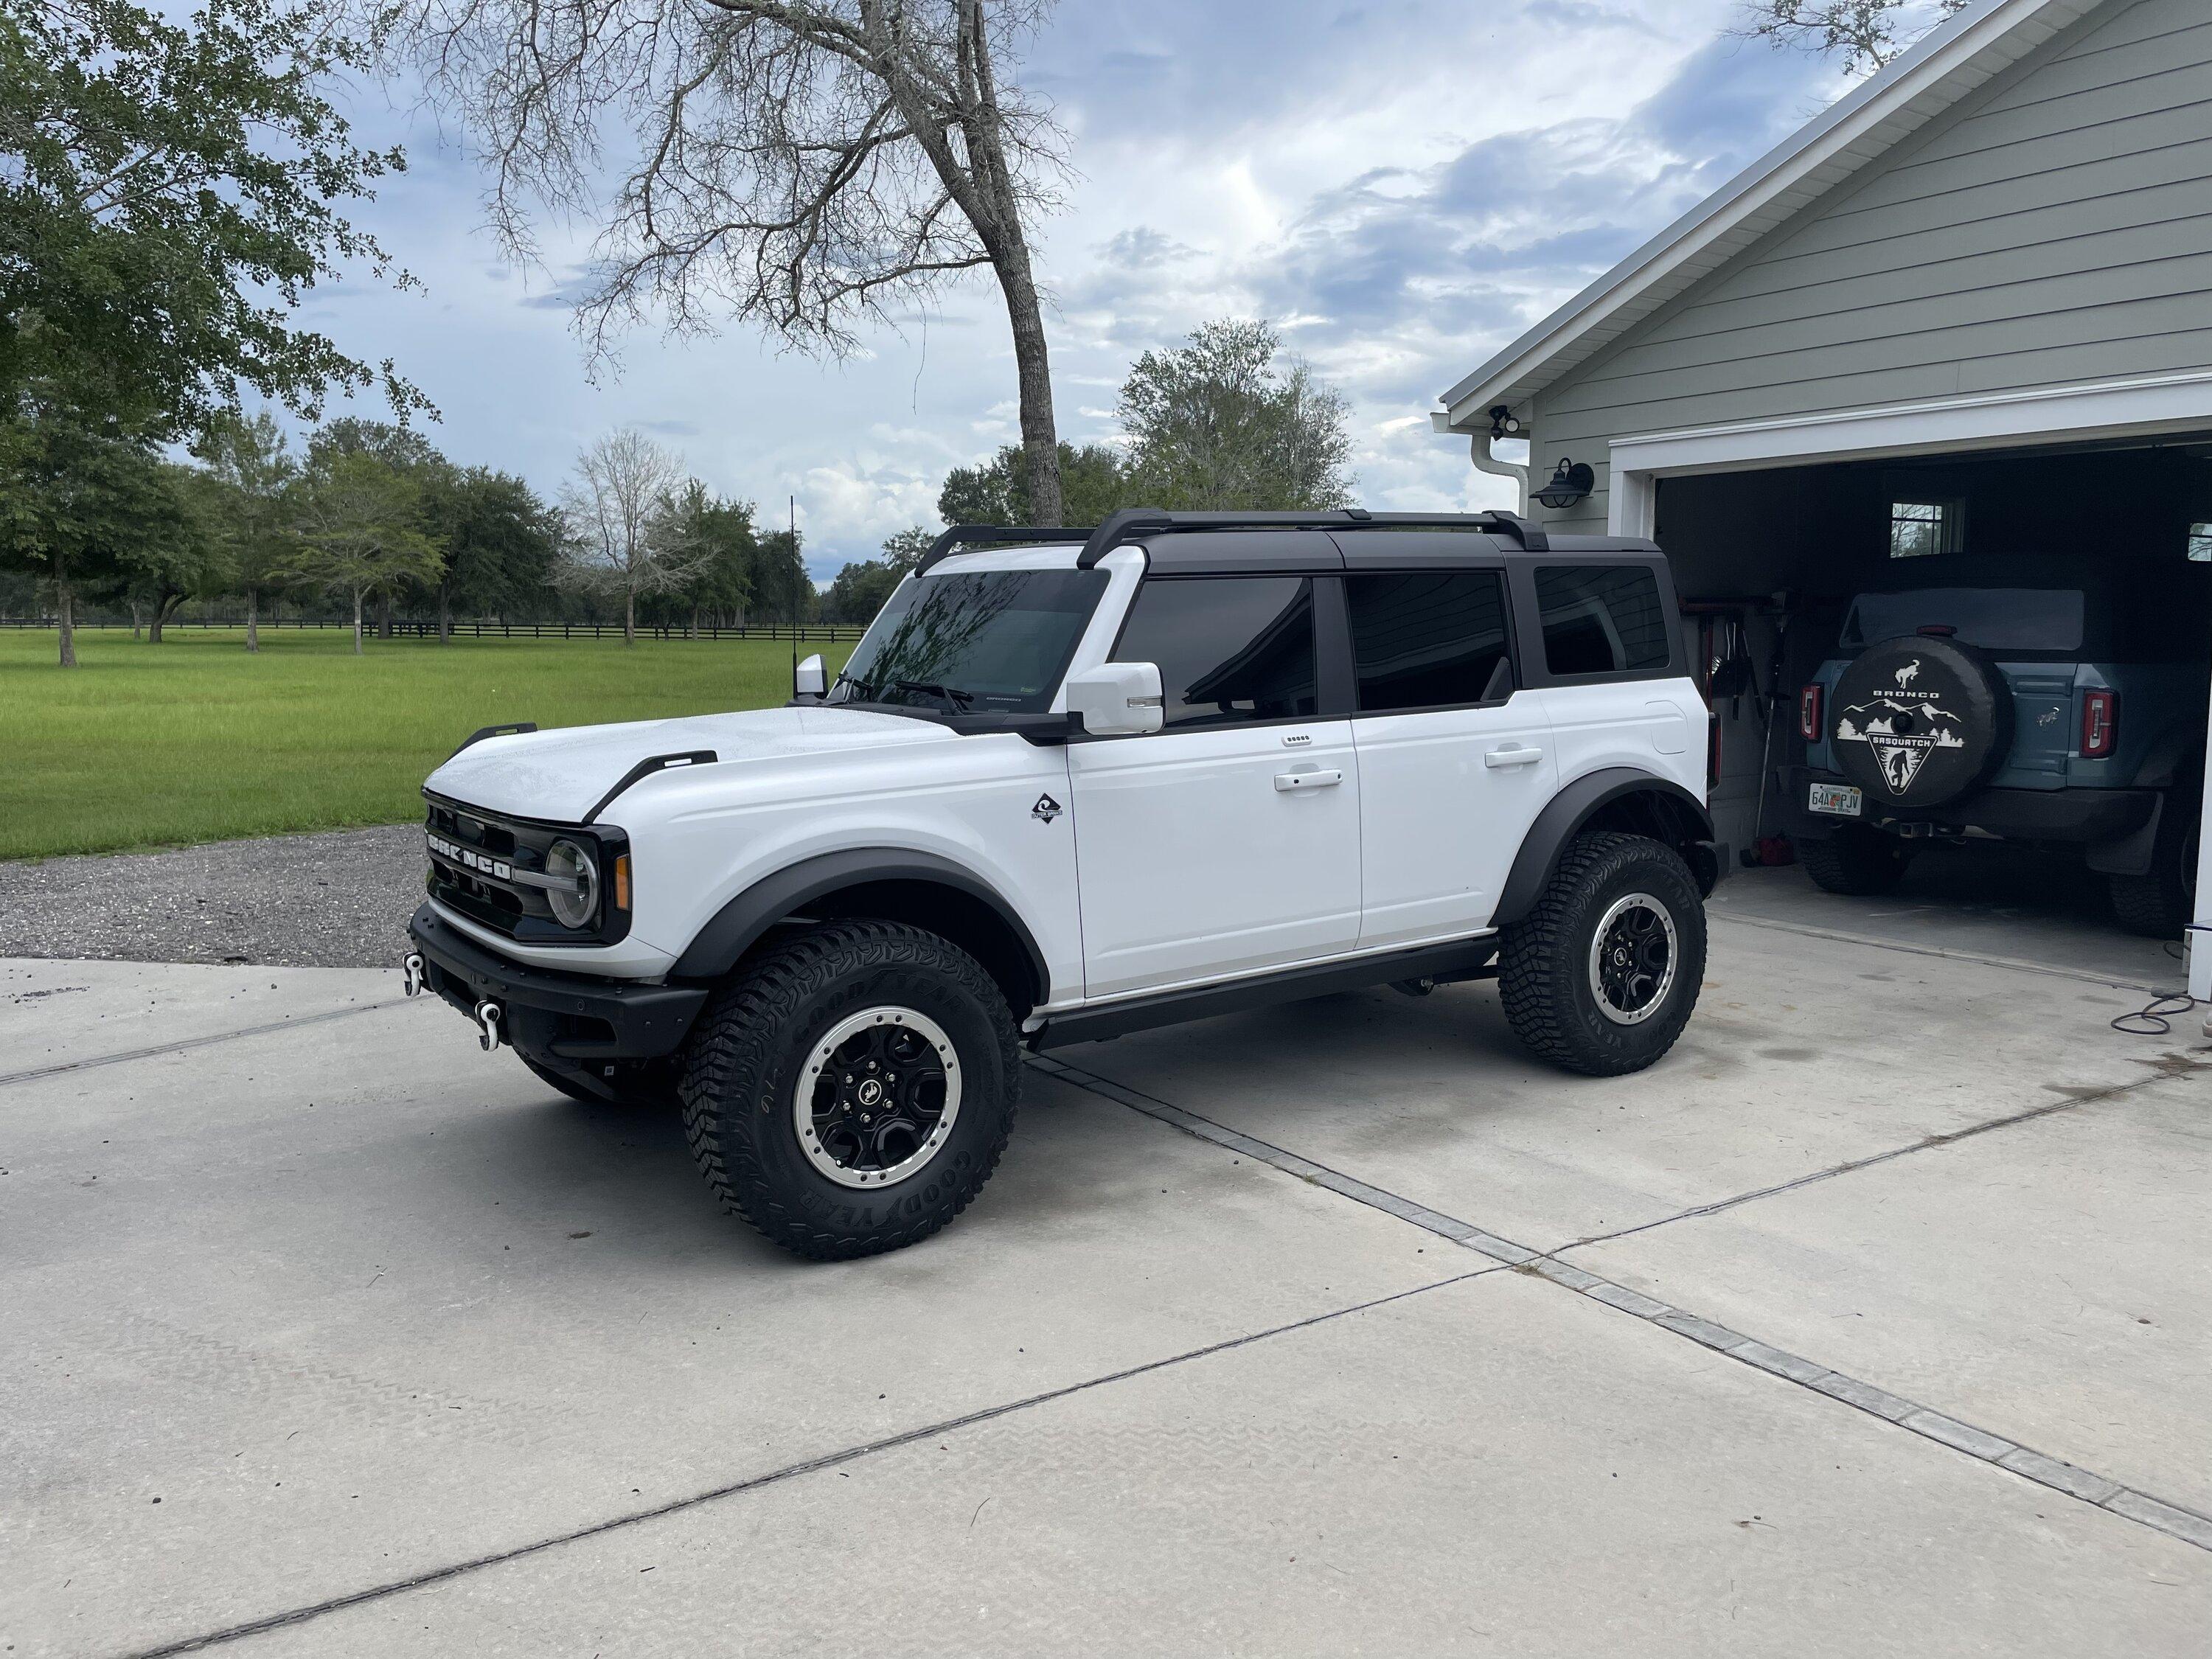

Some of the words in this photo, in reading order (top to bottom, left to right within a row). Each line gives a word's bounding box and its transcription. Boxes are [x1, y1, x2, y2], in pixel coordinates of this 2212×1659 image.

[1872, 689, 1939, 699] BRONCO
[1872, 736, 1931, 747] SASQUATCH
[1812, 791, 1829, 806] 64A
[1840, 794, 1858, 809] PJV
